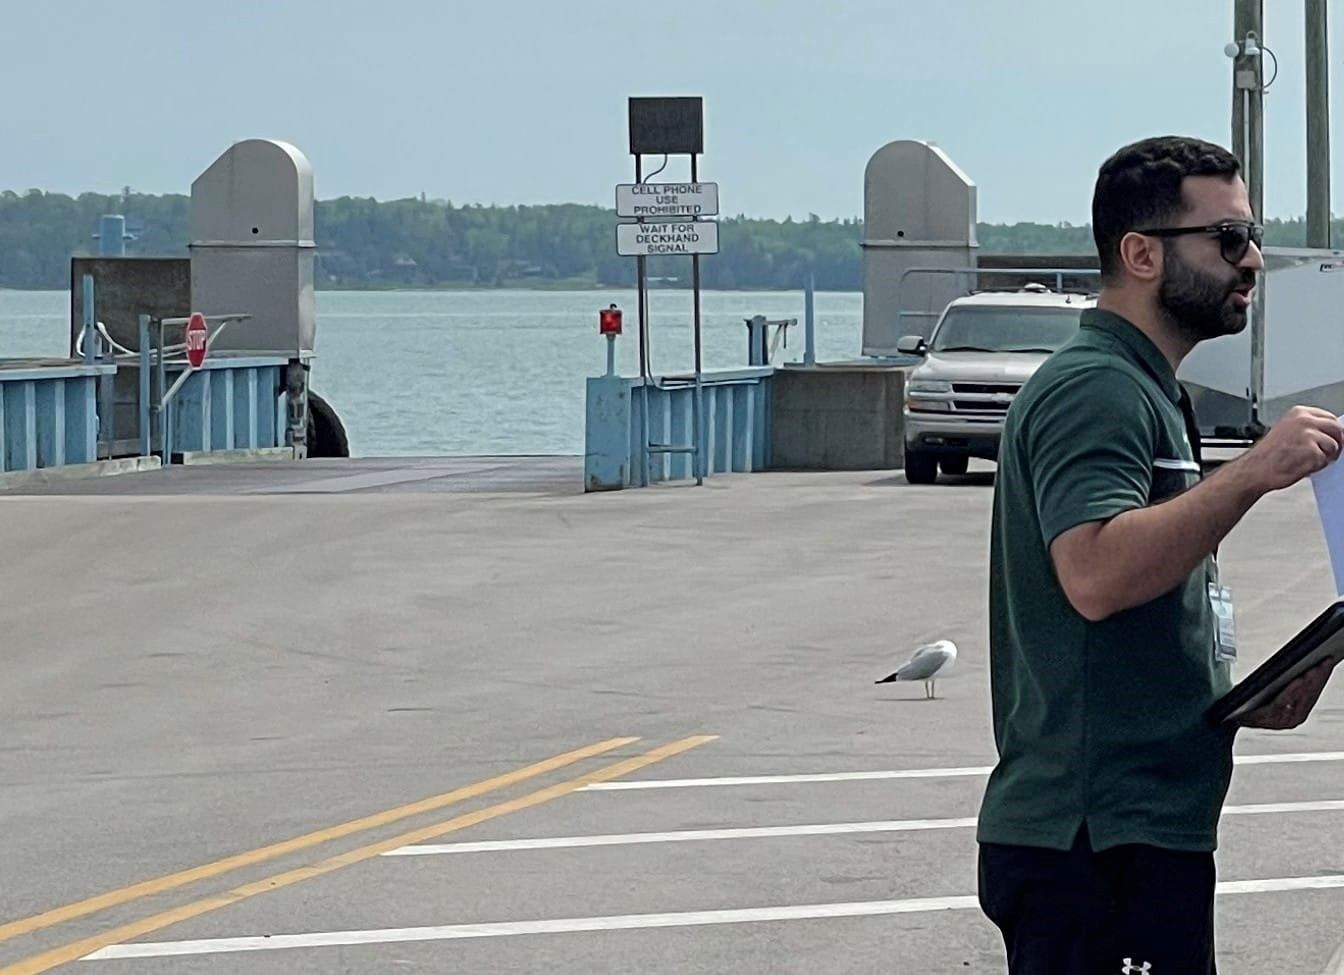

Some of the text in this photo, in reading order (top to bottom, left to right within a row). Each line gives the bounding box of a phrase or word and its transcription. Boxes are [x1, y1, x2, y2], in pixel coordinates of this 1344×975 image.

[631, 184, 702, 195] CELL PHONE
[655, 196, 678, 204] USE
[633, 205, 702, 215] PROHIBITED
[639, 224, 694, 234] WAIT FOR
[636, 234, 699, 244] DECKHAND
[647, 244, 688, 253] SIGNAL
[188, 330, 206, 350] STOP
